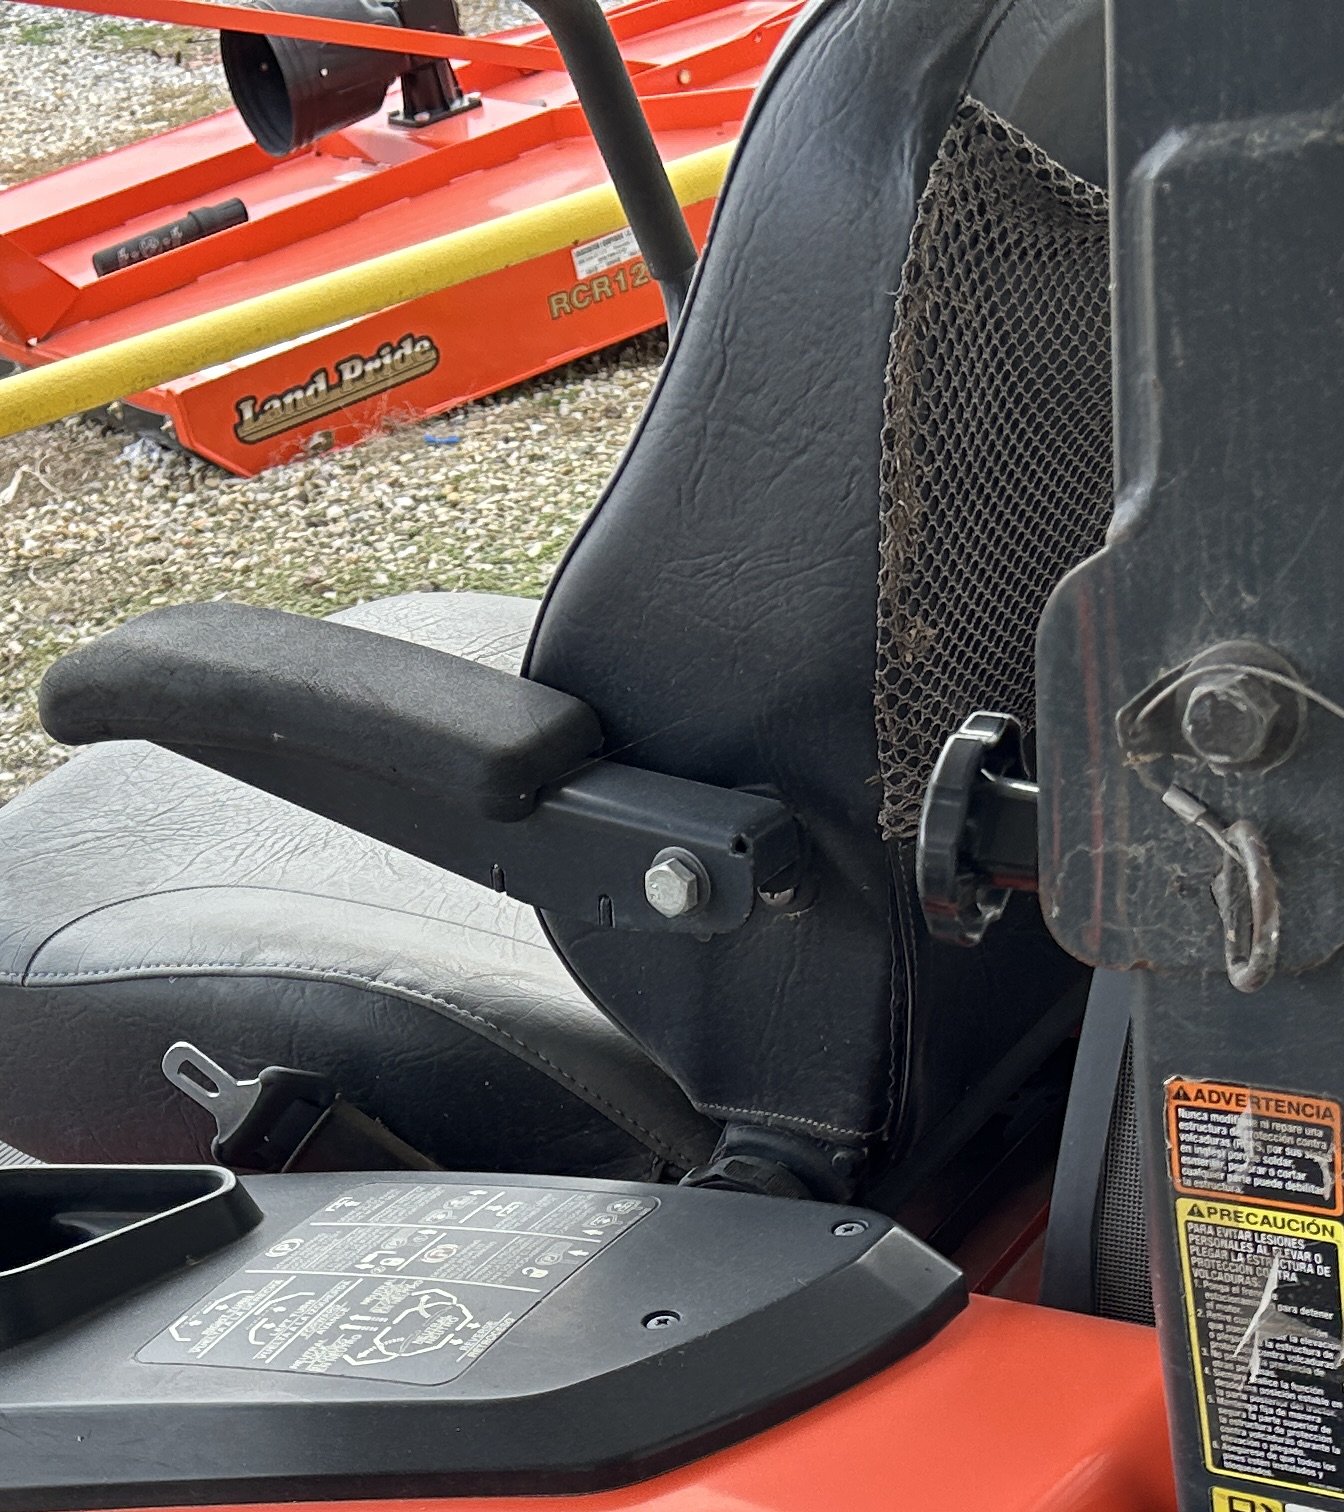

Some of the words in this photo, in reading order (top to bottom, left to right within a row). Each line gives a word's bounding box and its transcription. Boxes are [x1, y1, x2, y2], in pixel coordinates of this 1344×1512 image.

[237, 366, 331, 434] Land
[338, 334, 439, 396] Pride
[1193, 1087, 1334, 1121] ADVERTENCIA
[1186, 1222, 1215, 1236] PARA
[1215, 1227, 1252, 1242] EVITAR
[1254, 1232, 1305, 1250] LESIONES
[1206, 1203, 1334, 1237] PRECAUCIÓN
[1316, 1264, 1331, 1277] DE
